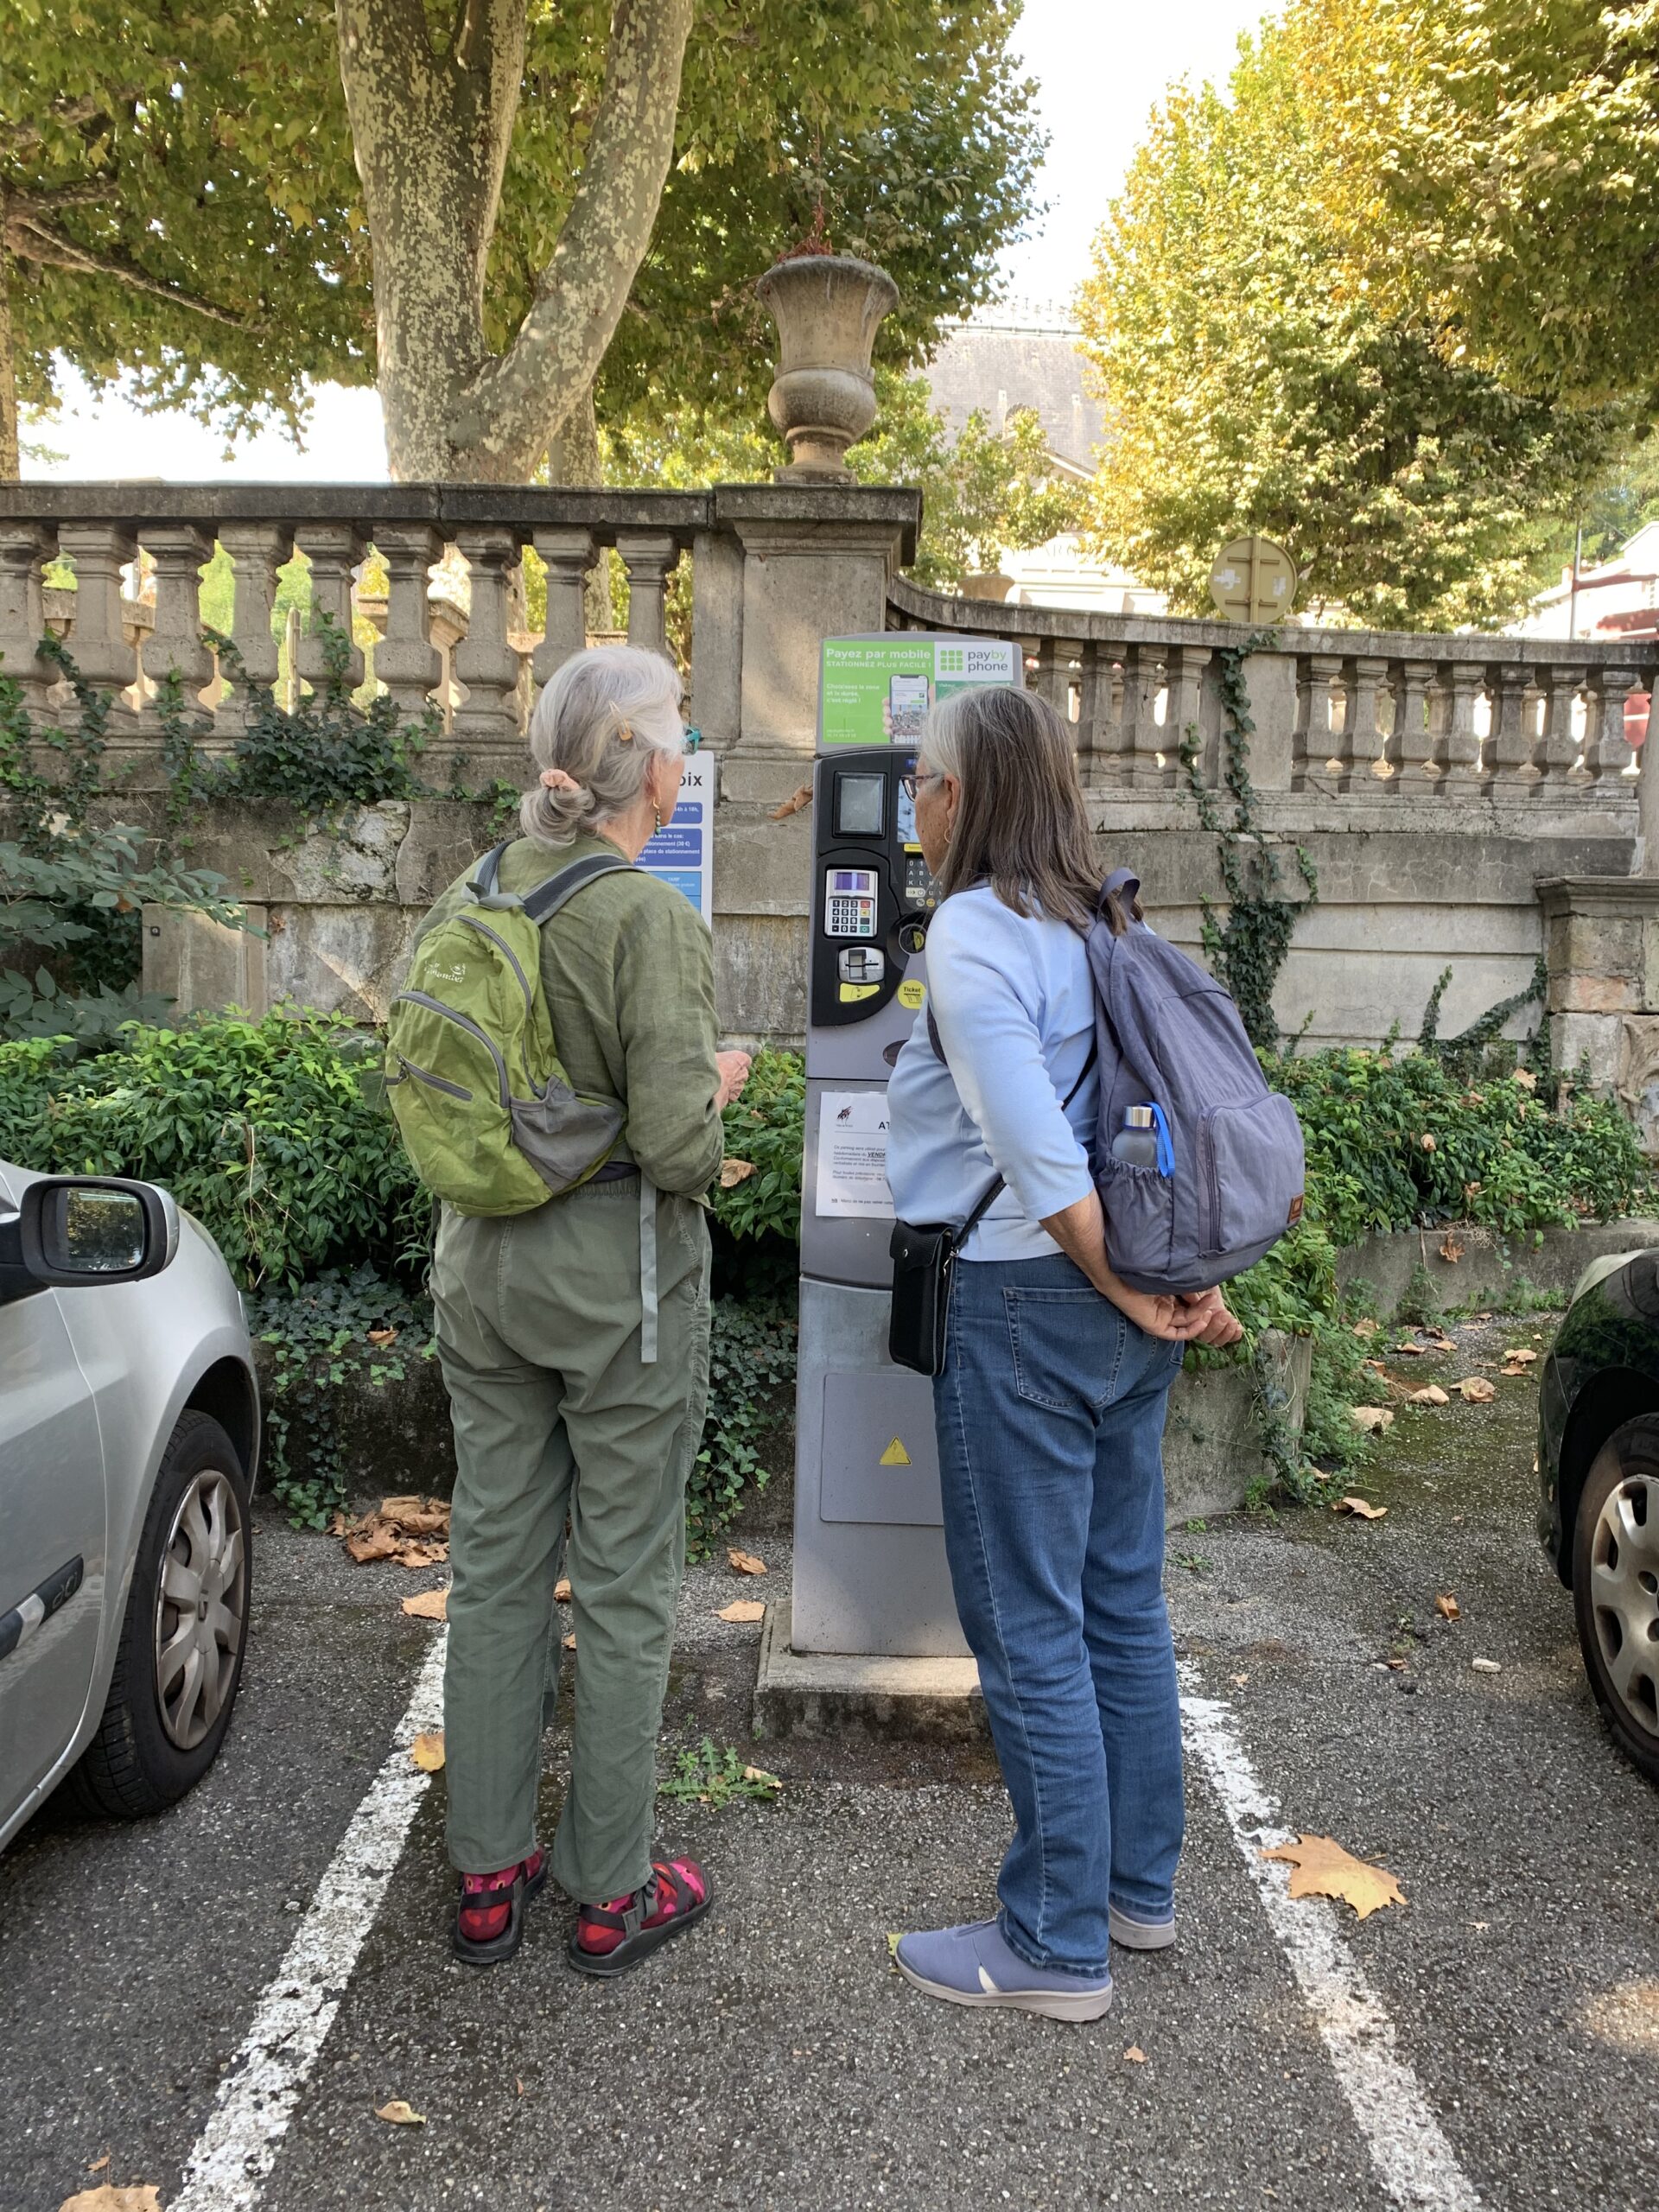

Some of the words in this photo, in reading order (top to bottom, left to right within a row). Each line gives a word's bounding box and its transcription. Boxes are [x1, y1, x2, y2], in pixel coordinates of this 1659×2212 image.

[826, 649, 862, 660] Payez
[866, 651, 887, 660] par
[890, 650, 931, 658] mobile
[968, 661, 1008, 673] phone
